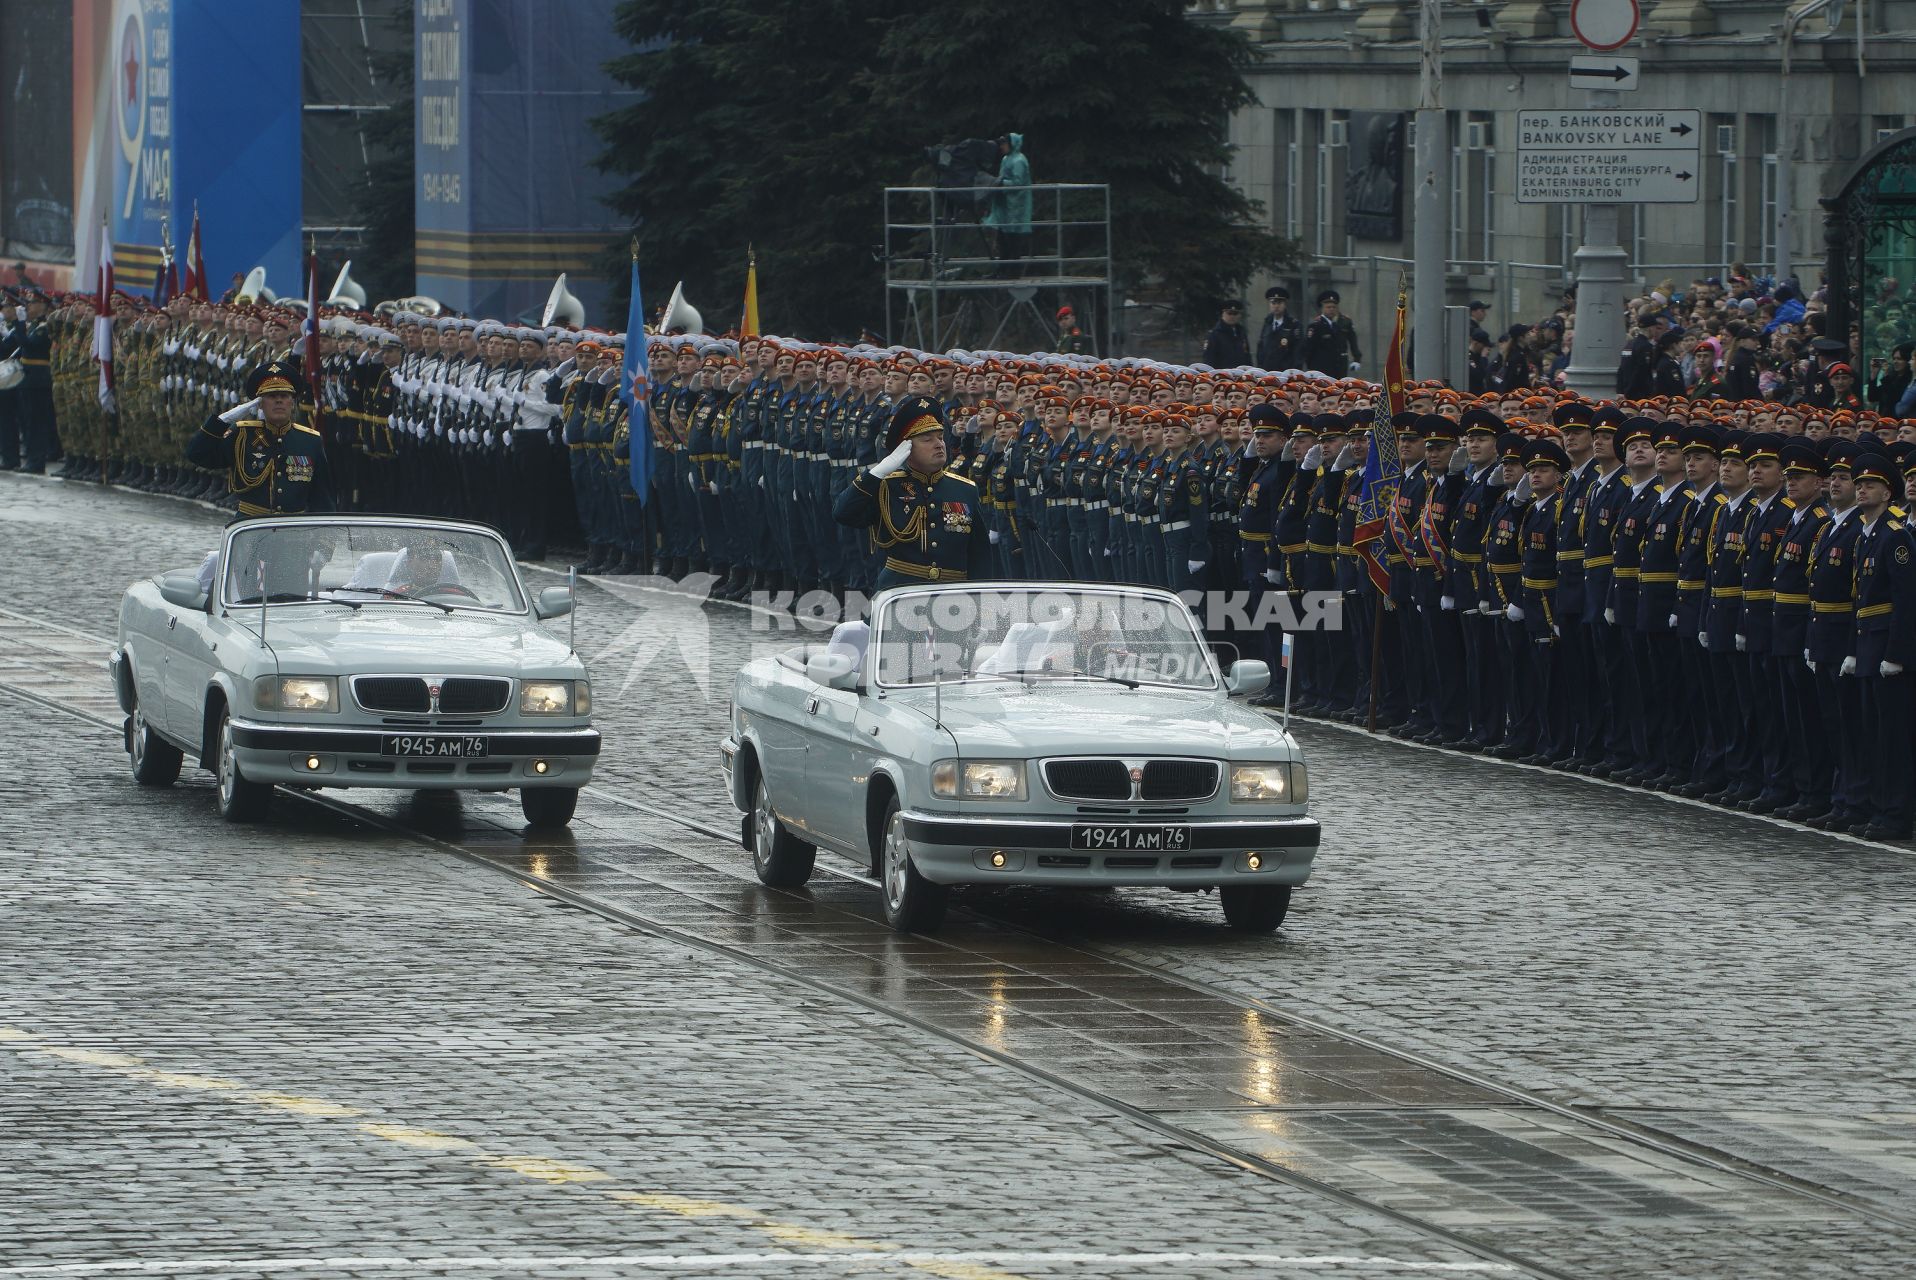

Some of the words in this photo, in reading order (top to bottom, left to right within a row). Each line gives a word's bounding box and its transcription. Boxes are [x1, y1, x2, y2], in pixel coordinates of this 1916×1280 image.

[1523, 118, 1553, 129] пер.
[1560, 113, 1665, 127] БАНКОВСКИЙ
[1523, 132, 1616, 143] BANKOVSKY
[1623, 132, 1662, 143] LANE
[1523, 155, 1627, 164] АДМИНИСТРАЦИЯ
[142, 148, 170, 201] МАЯ
[1522, 166, 1568, 175] ГОРОДА
[1573, 166, 1672, 175] ЕКАТЕРИНБУРГА
[1522, 178, 1611, 187] EKATERINBURG
[1615, 178, 1641, 187] CITY
[1523, 188, 1622, 197] ADMINISTRATION
